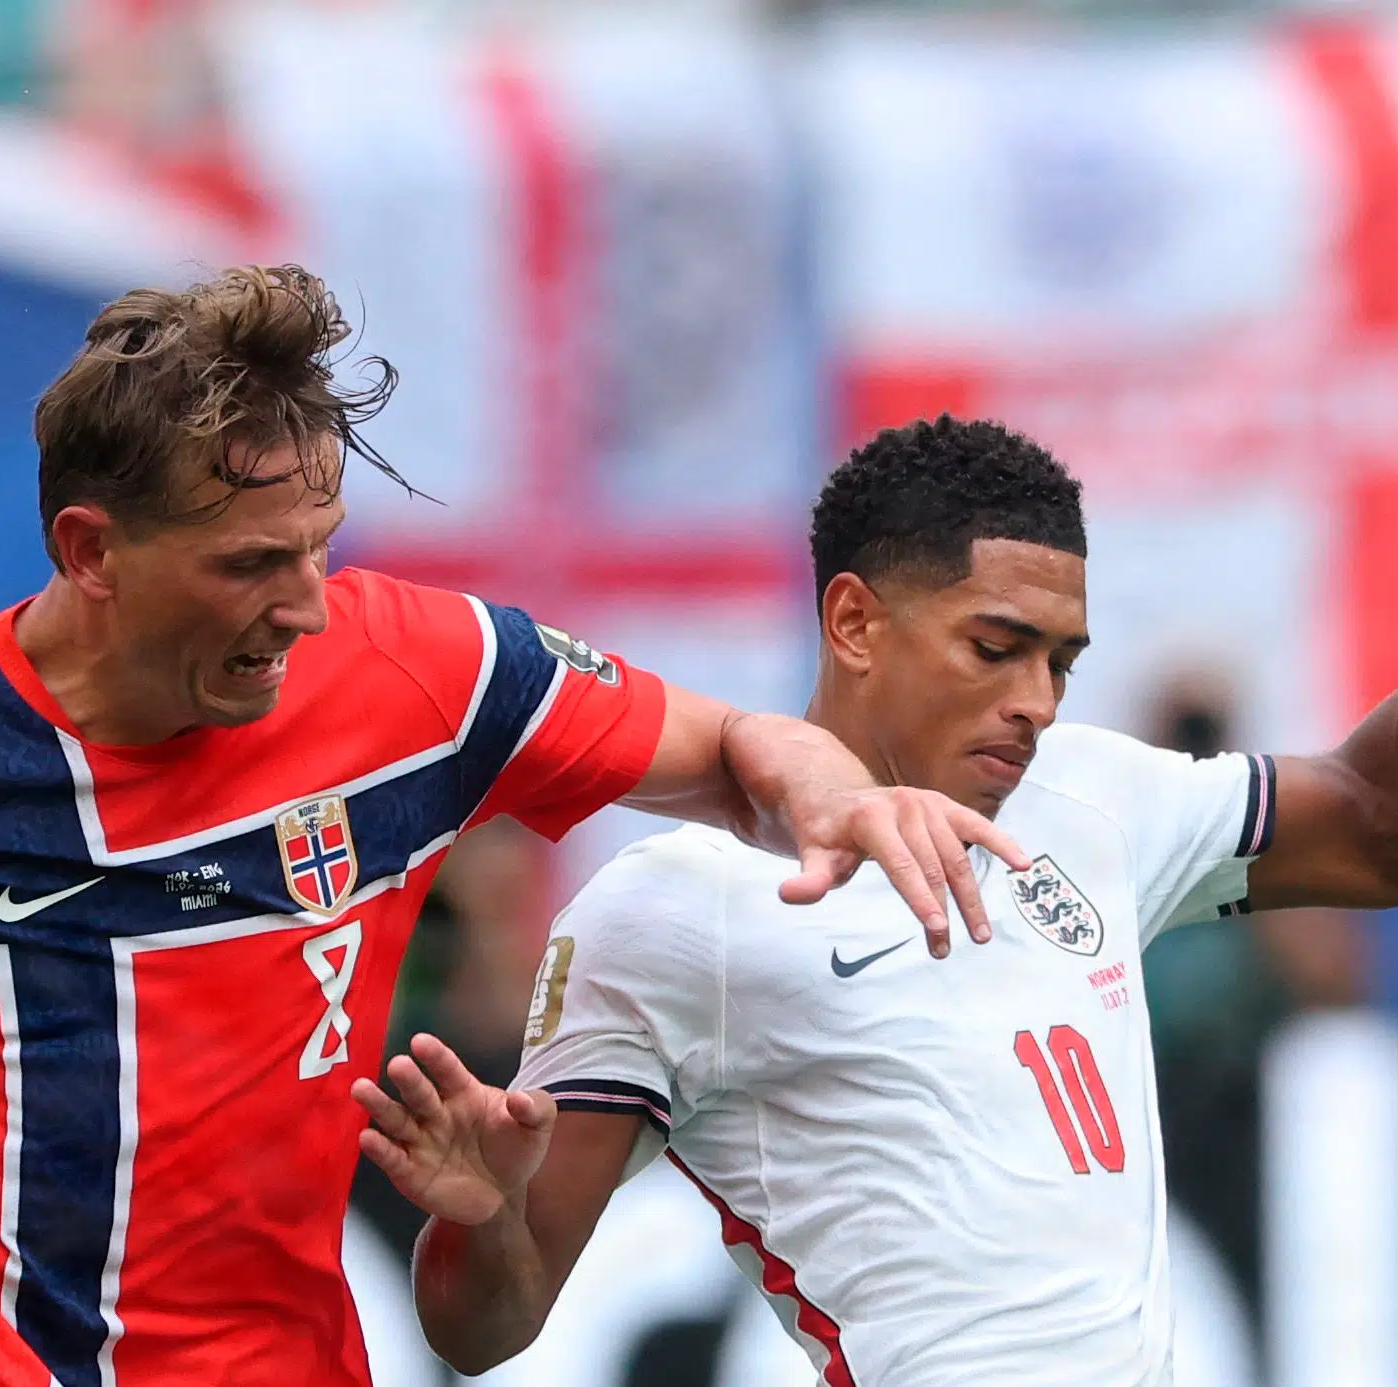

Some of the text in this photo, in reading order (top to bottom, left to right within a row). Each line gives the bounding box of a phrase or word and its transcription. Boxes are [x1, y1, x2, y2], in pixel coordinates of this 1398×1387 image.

[180, 893, 218, 912] MIAMI
[299, 919, 363, 1081] 8
[1087, 960, 1126, 990] NORWAY
[1013, 1024, 1126, 1175] 10
